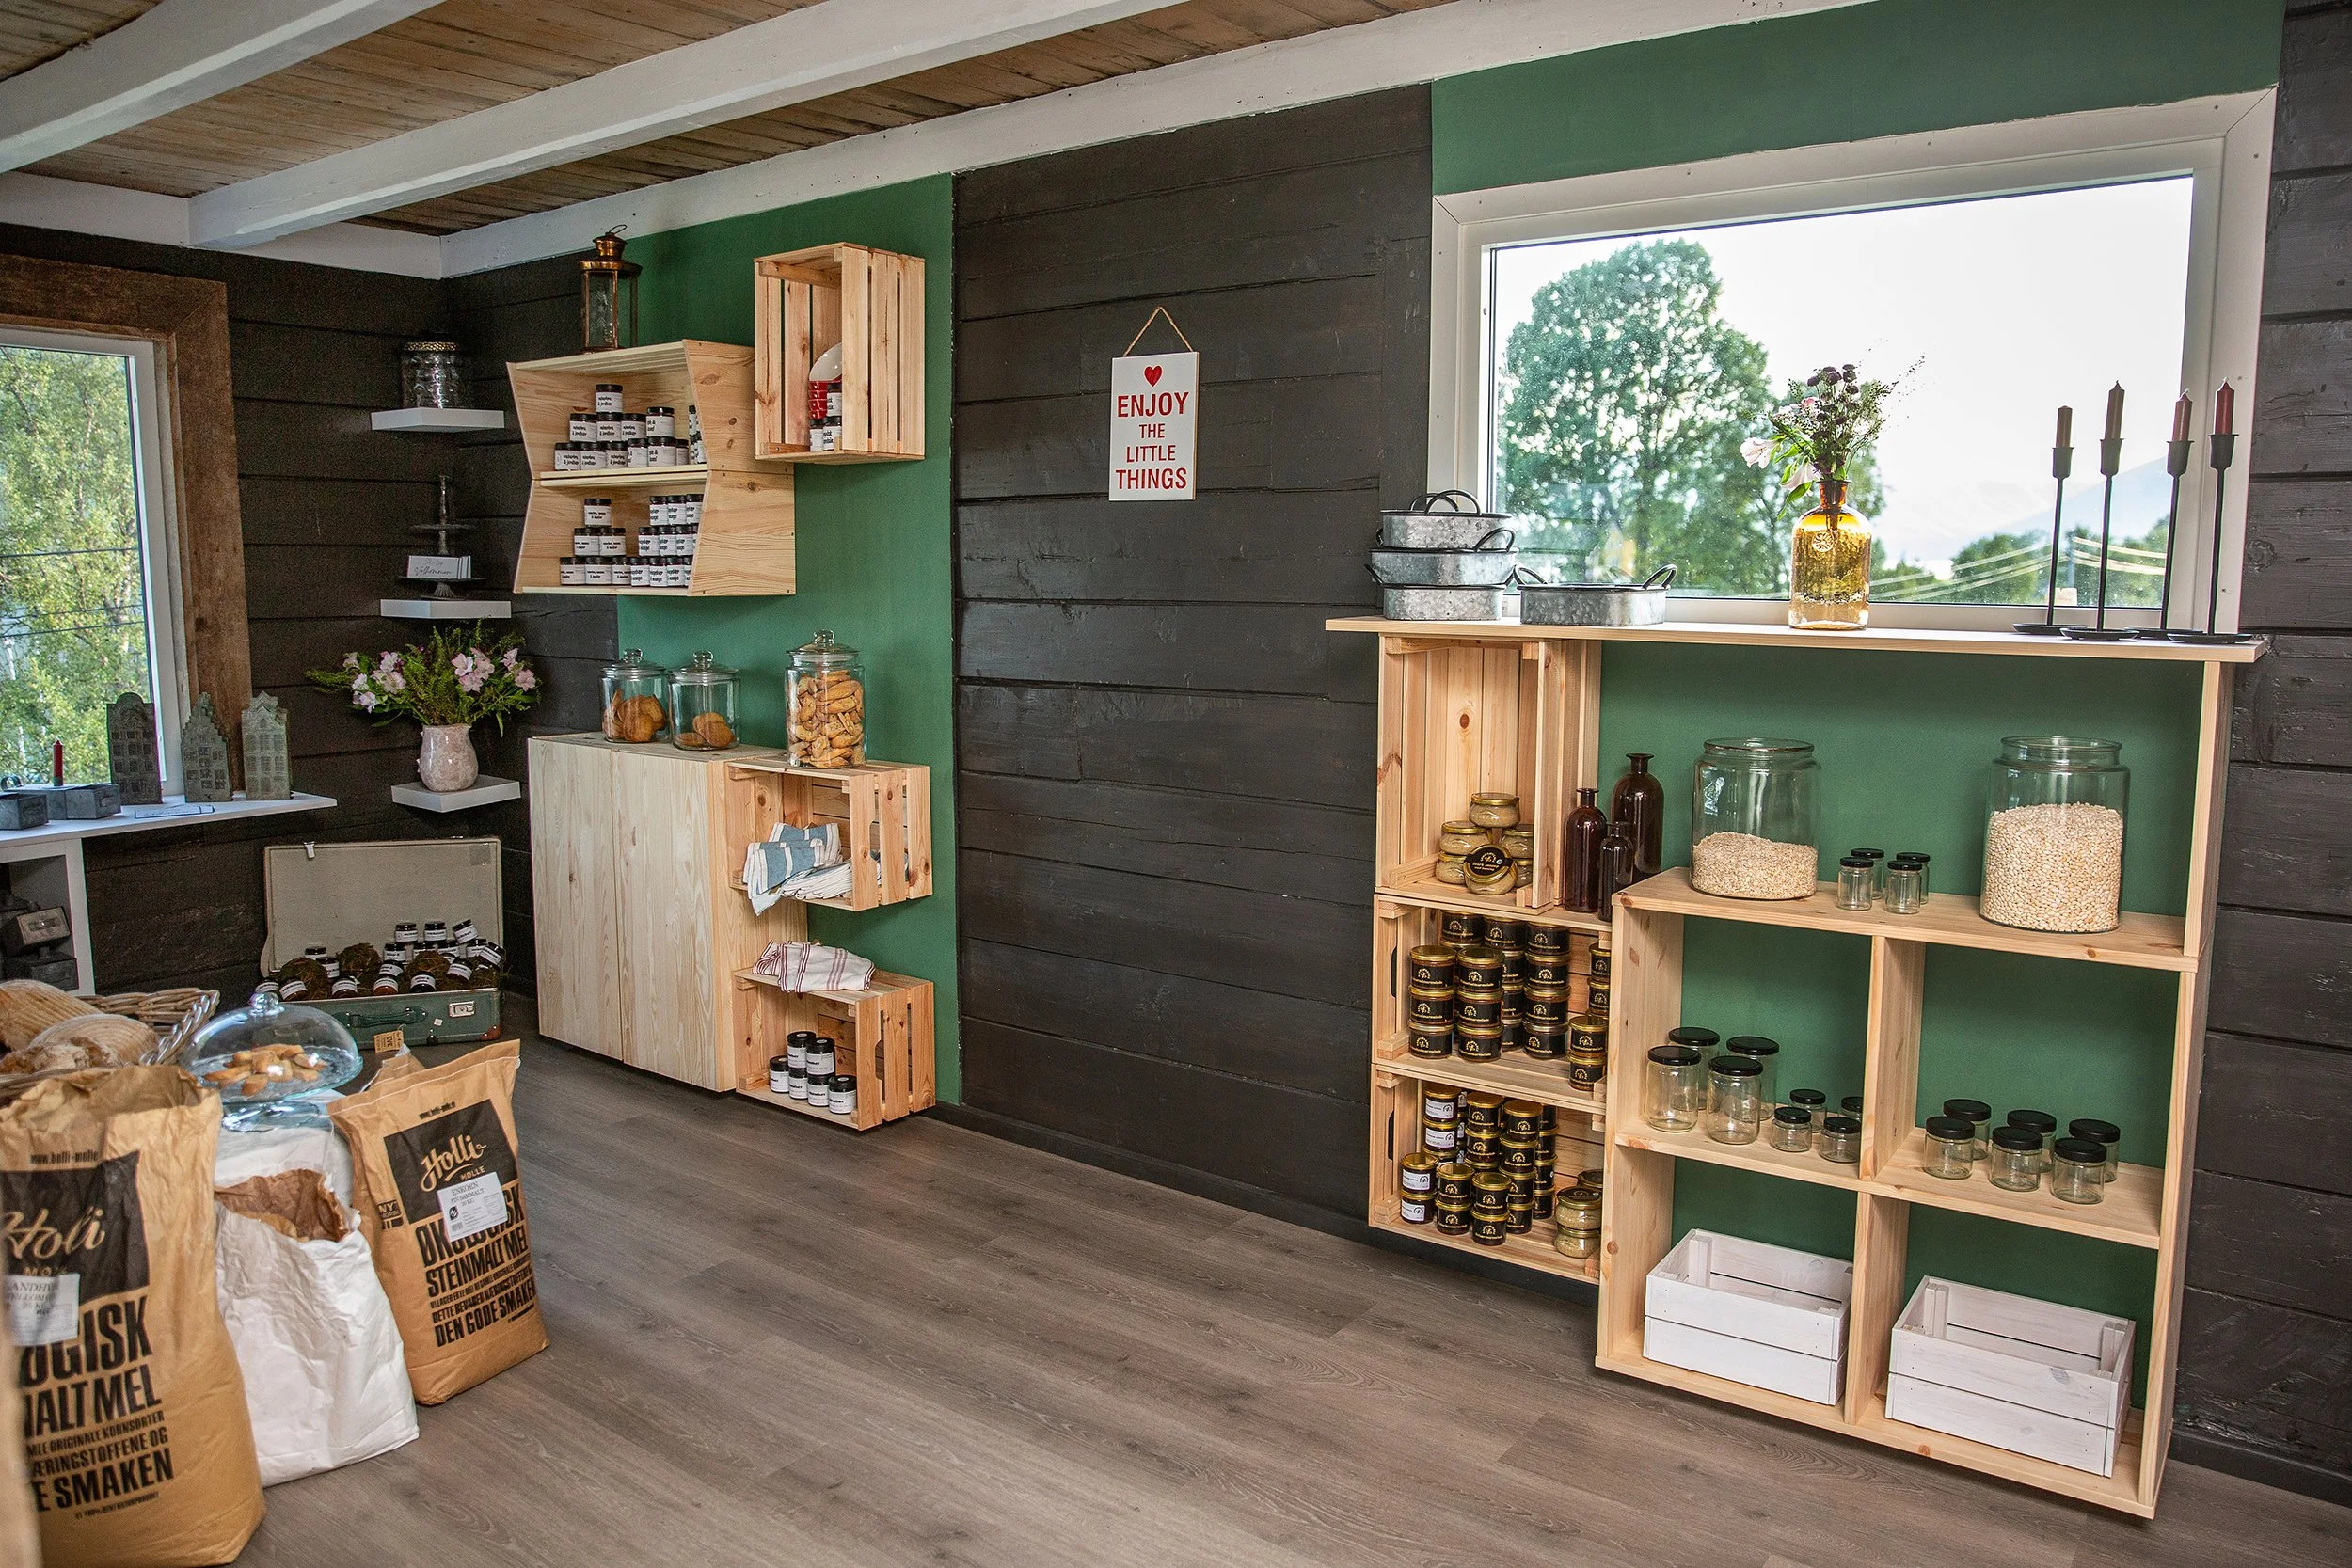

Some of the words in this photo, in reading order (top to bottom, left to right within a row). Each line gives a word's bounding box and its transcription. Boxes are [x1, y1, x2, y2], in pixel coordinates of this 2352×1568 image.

[1117, 391, 1189, 418] ENJOY
[1138, 423, 1166, 439] THE
[1126, 444, 1176, 463] LITTLE
[1116, 467, 1187, 490] THINGS
[421, 1134, 487, 1192] Holli
[452, 1181, 479, 1196] ENKORN
[425, 1238, 505, 1298] STEINMALT
[504, 1224, 529, 1260] MEL
[432, 1307, 455, 1323] DETTE
[435, 1318, 465, 1348] DEN
[465, 1301, 500, 1335] GODE
[94, 1364, 162, 1424] MEL
[51, 1430, 102, 1452] ORIGINALE
[150, 1426, 168, 1448] OG
[53, 1447, 175, 1509] SMAKEN
